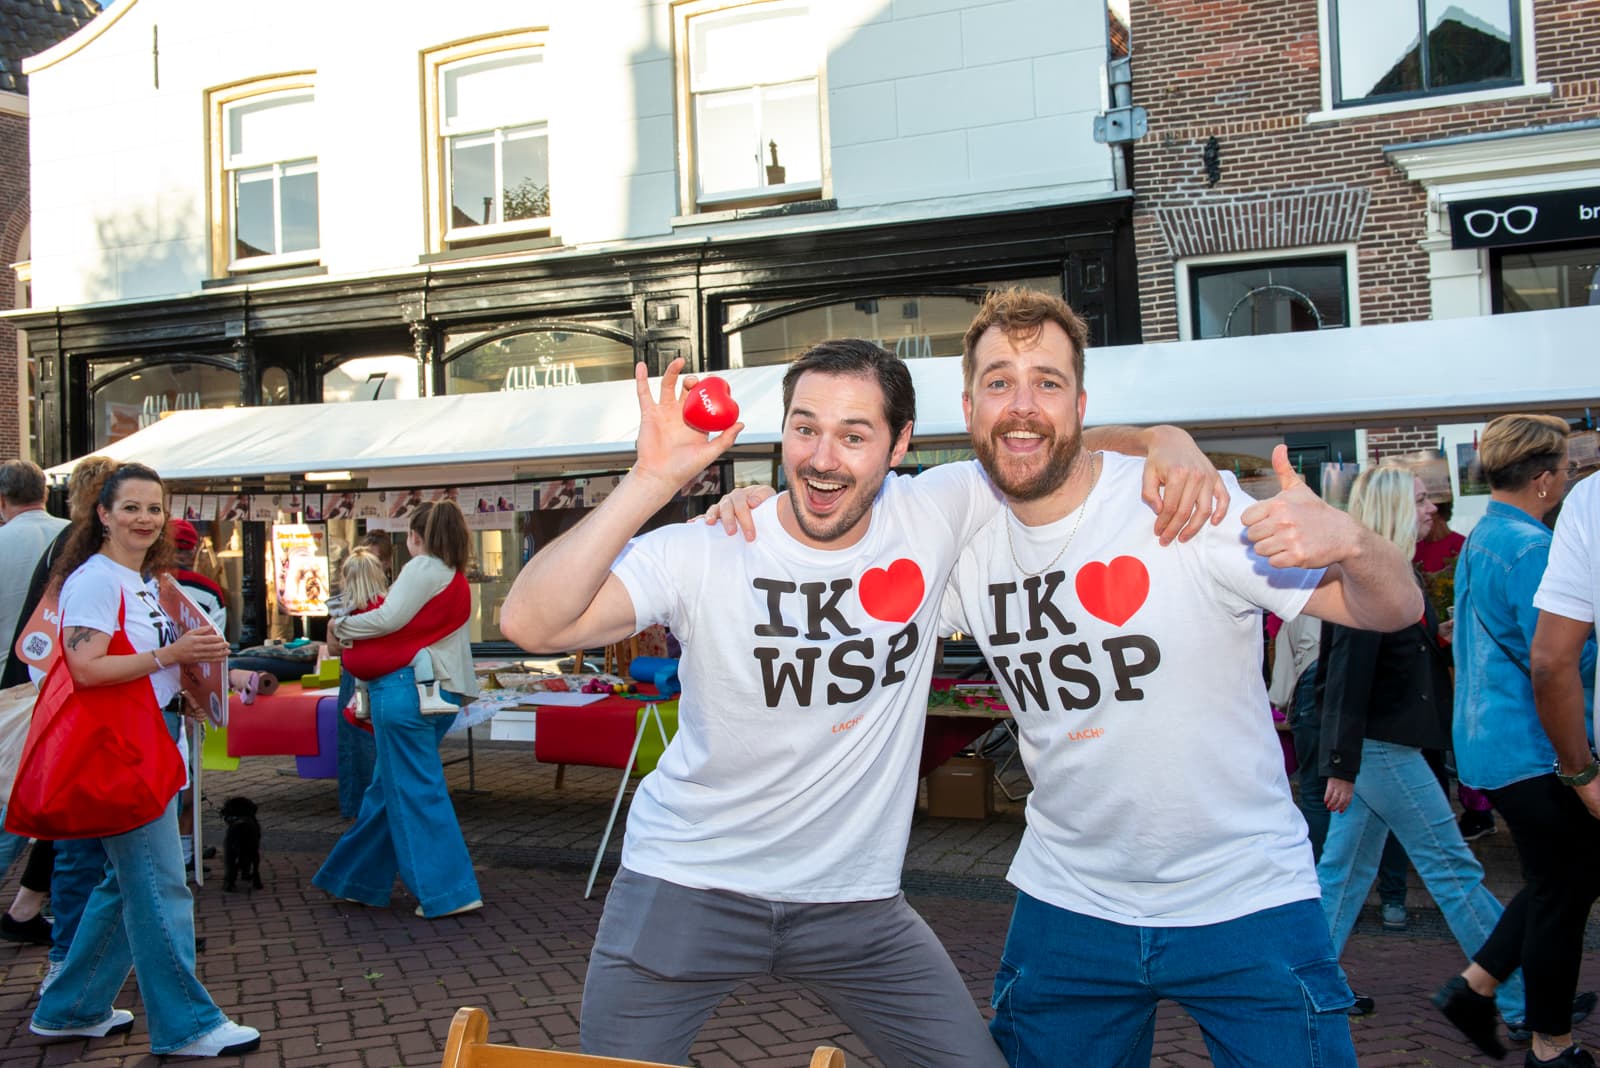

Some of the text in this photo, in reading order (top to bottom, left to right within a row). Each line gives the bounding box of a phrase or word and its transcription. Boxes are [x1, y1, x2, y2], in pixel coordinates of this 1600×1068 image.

[366, 372, 388, 400] 7
[753, 577, 861, 640] IK
[988, 570, 1077, 646] IK
[753, 622, 919, 707] WSP
[992, 634, 1161, 712] WSP
